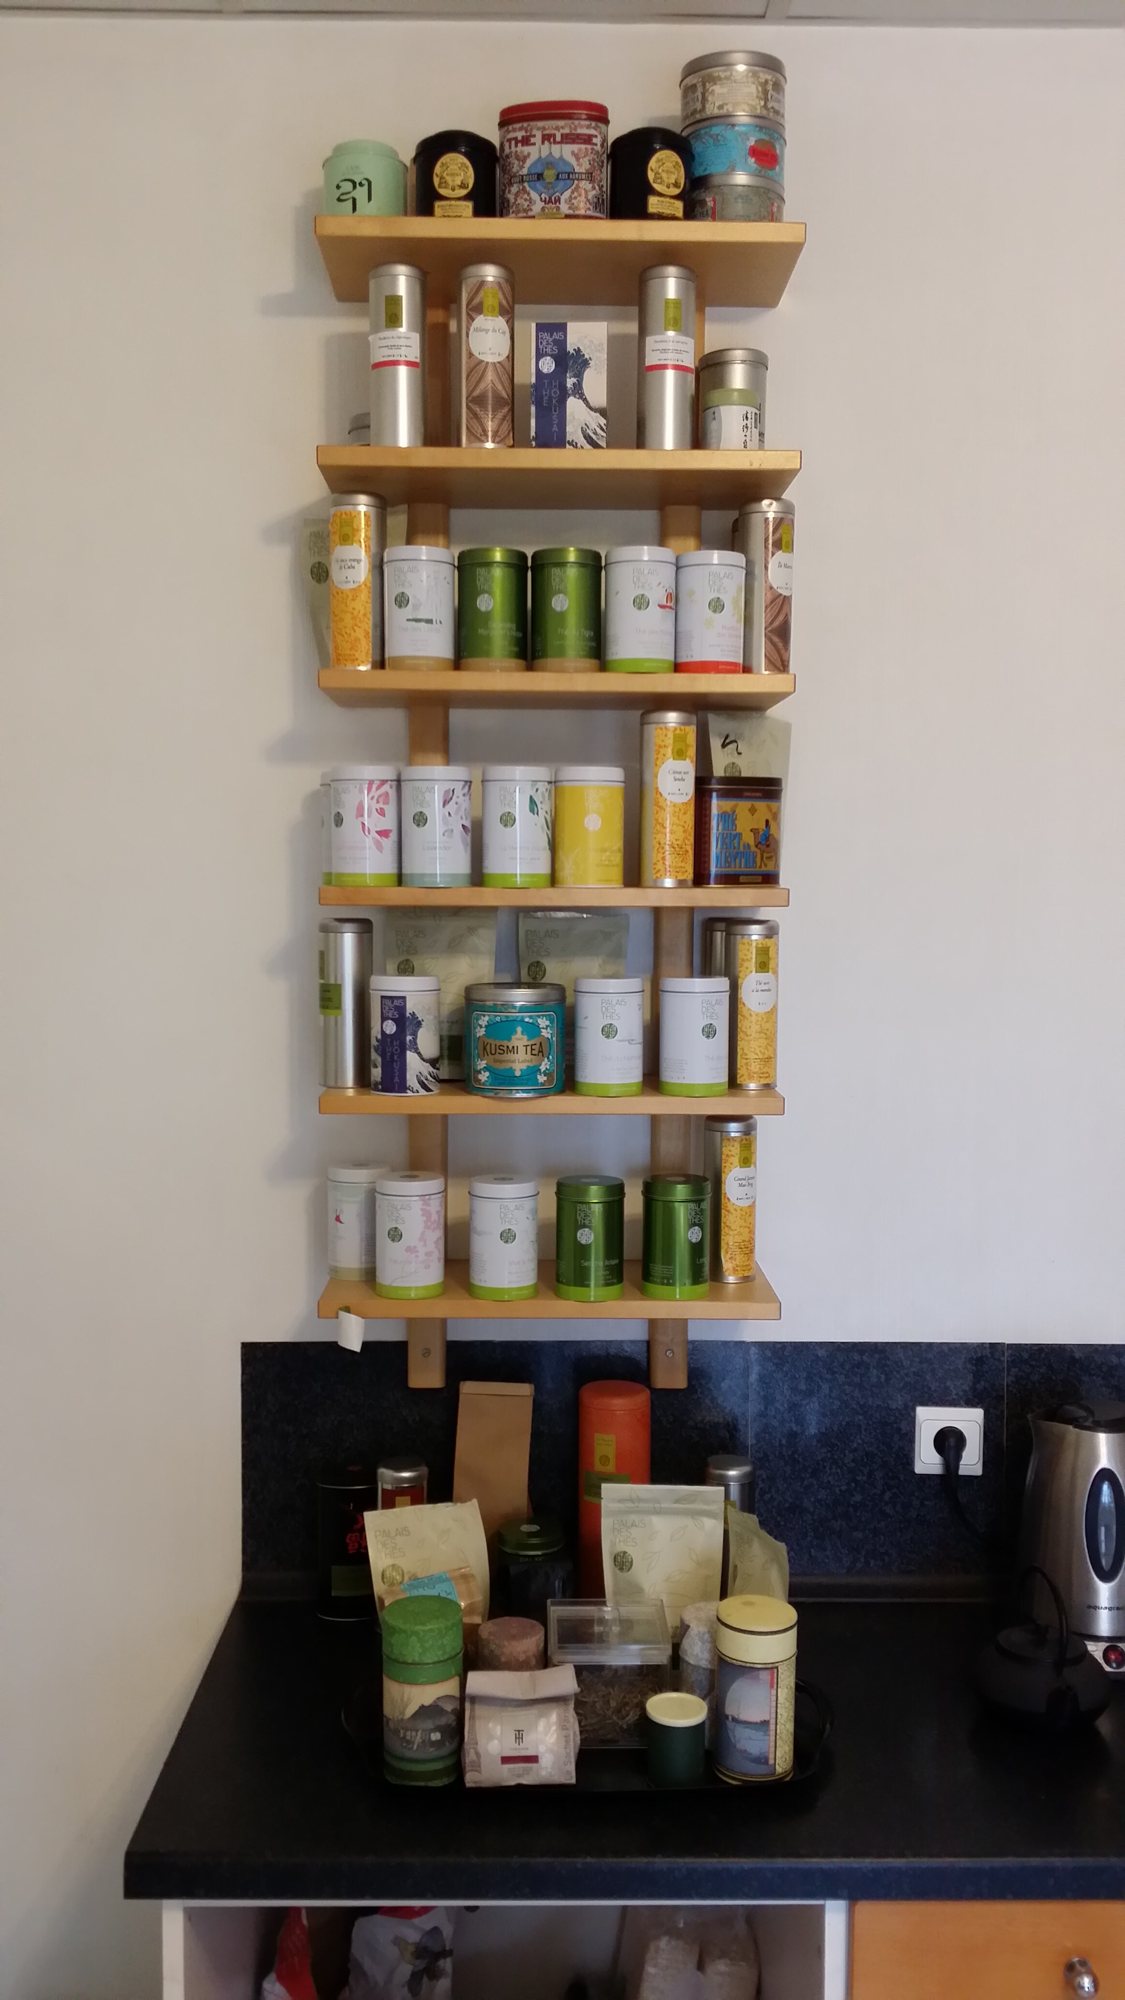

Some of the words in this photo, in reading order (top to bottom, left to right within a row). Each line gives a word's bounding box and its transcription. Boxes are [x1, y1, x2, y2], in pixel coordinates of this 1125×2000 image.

[541, 132, 598, 147] RUSSE
[538, 331, 565, 340] PALAIS
[482, 1040, 519, 1058] KUSMI
[522, 1041, 545, 1058] TEA
